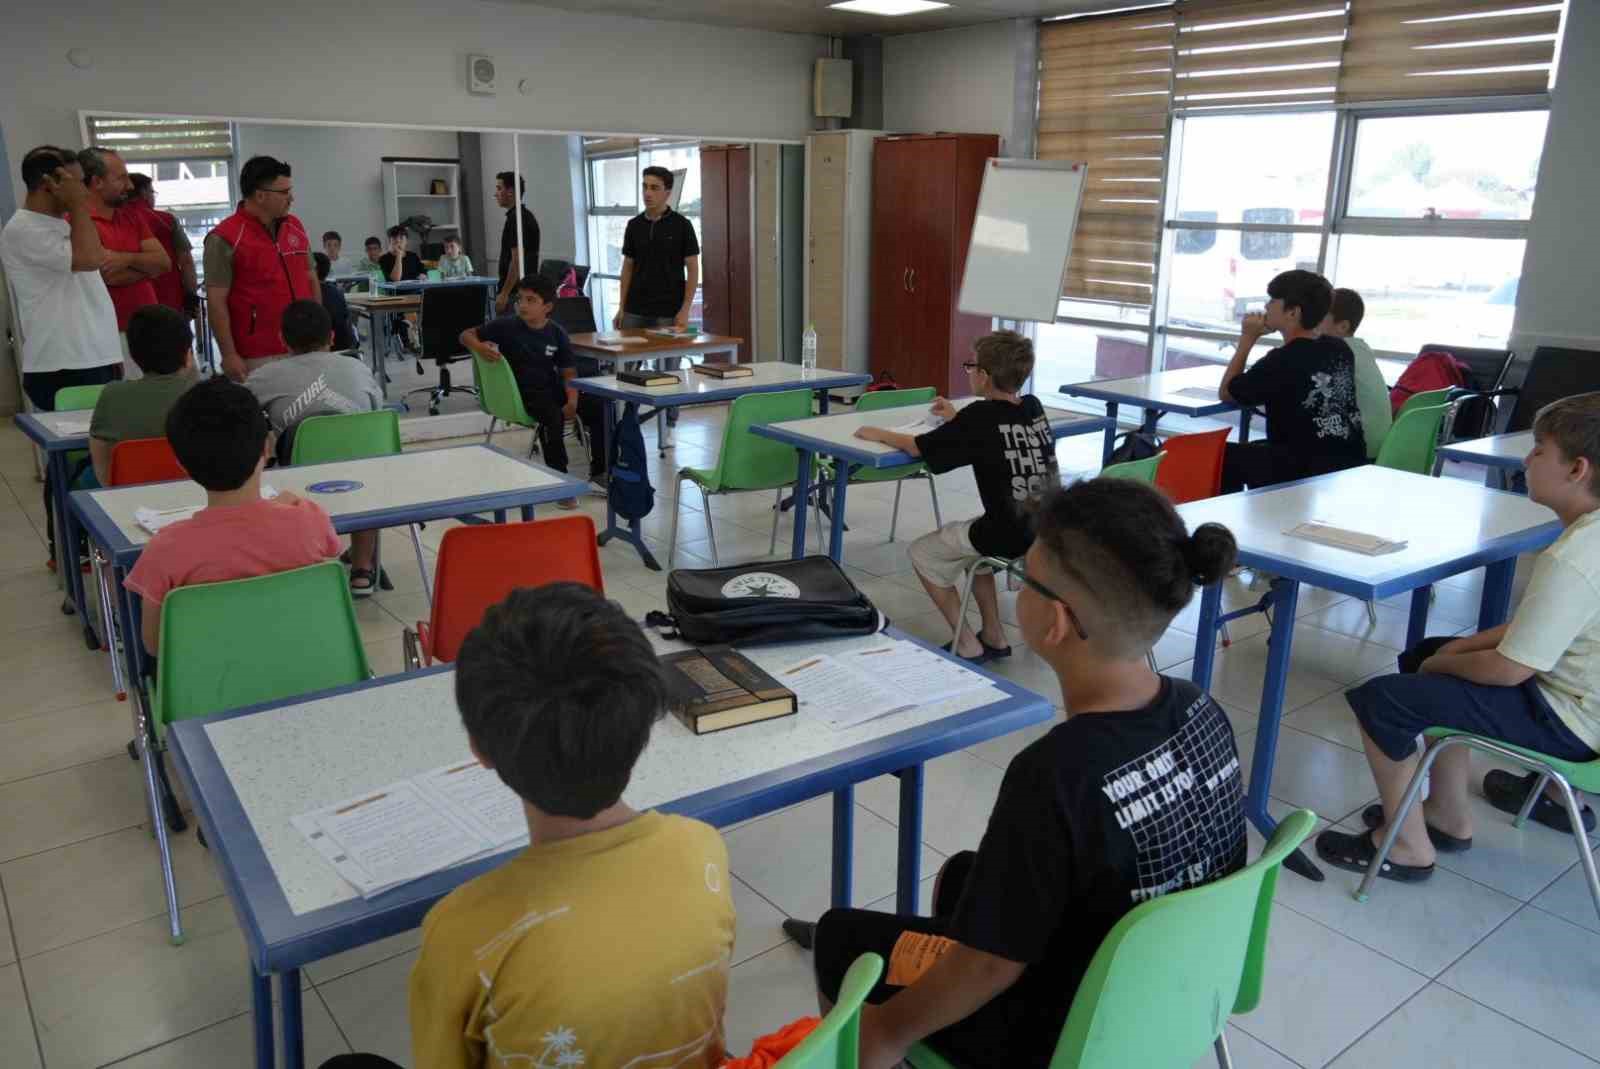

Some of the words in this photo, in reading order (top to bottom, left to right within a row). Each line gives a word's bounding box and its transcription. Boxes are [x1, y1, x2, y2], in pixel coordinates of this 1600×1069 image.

[282, 373, 328, 425] FUTURE
[998, 420, 1052, 449] TASTE
[1004, 448, 1048, 475] THE
[1101, 768, 1146, 803] YOUR
[1114, 793, 1162, 830] LIMIT
[1160, 779, 1178, 806] IS
